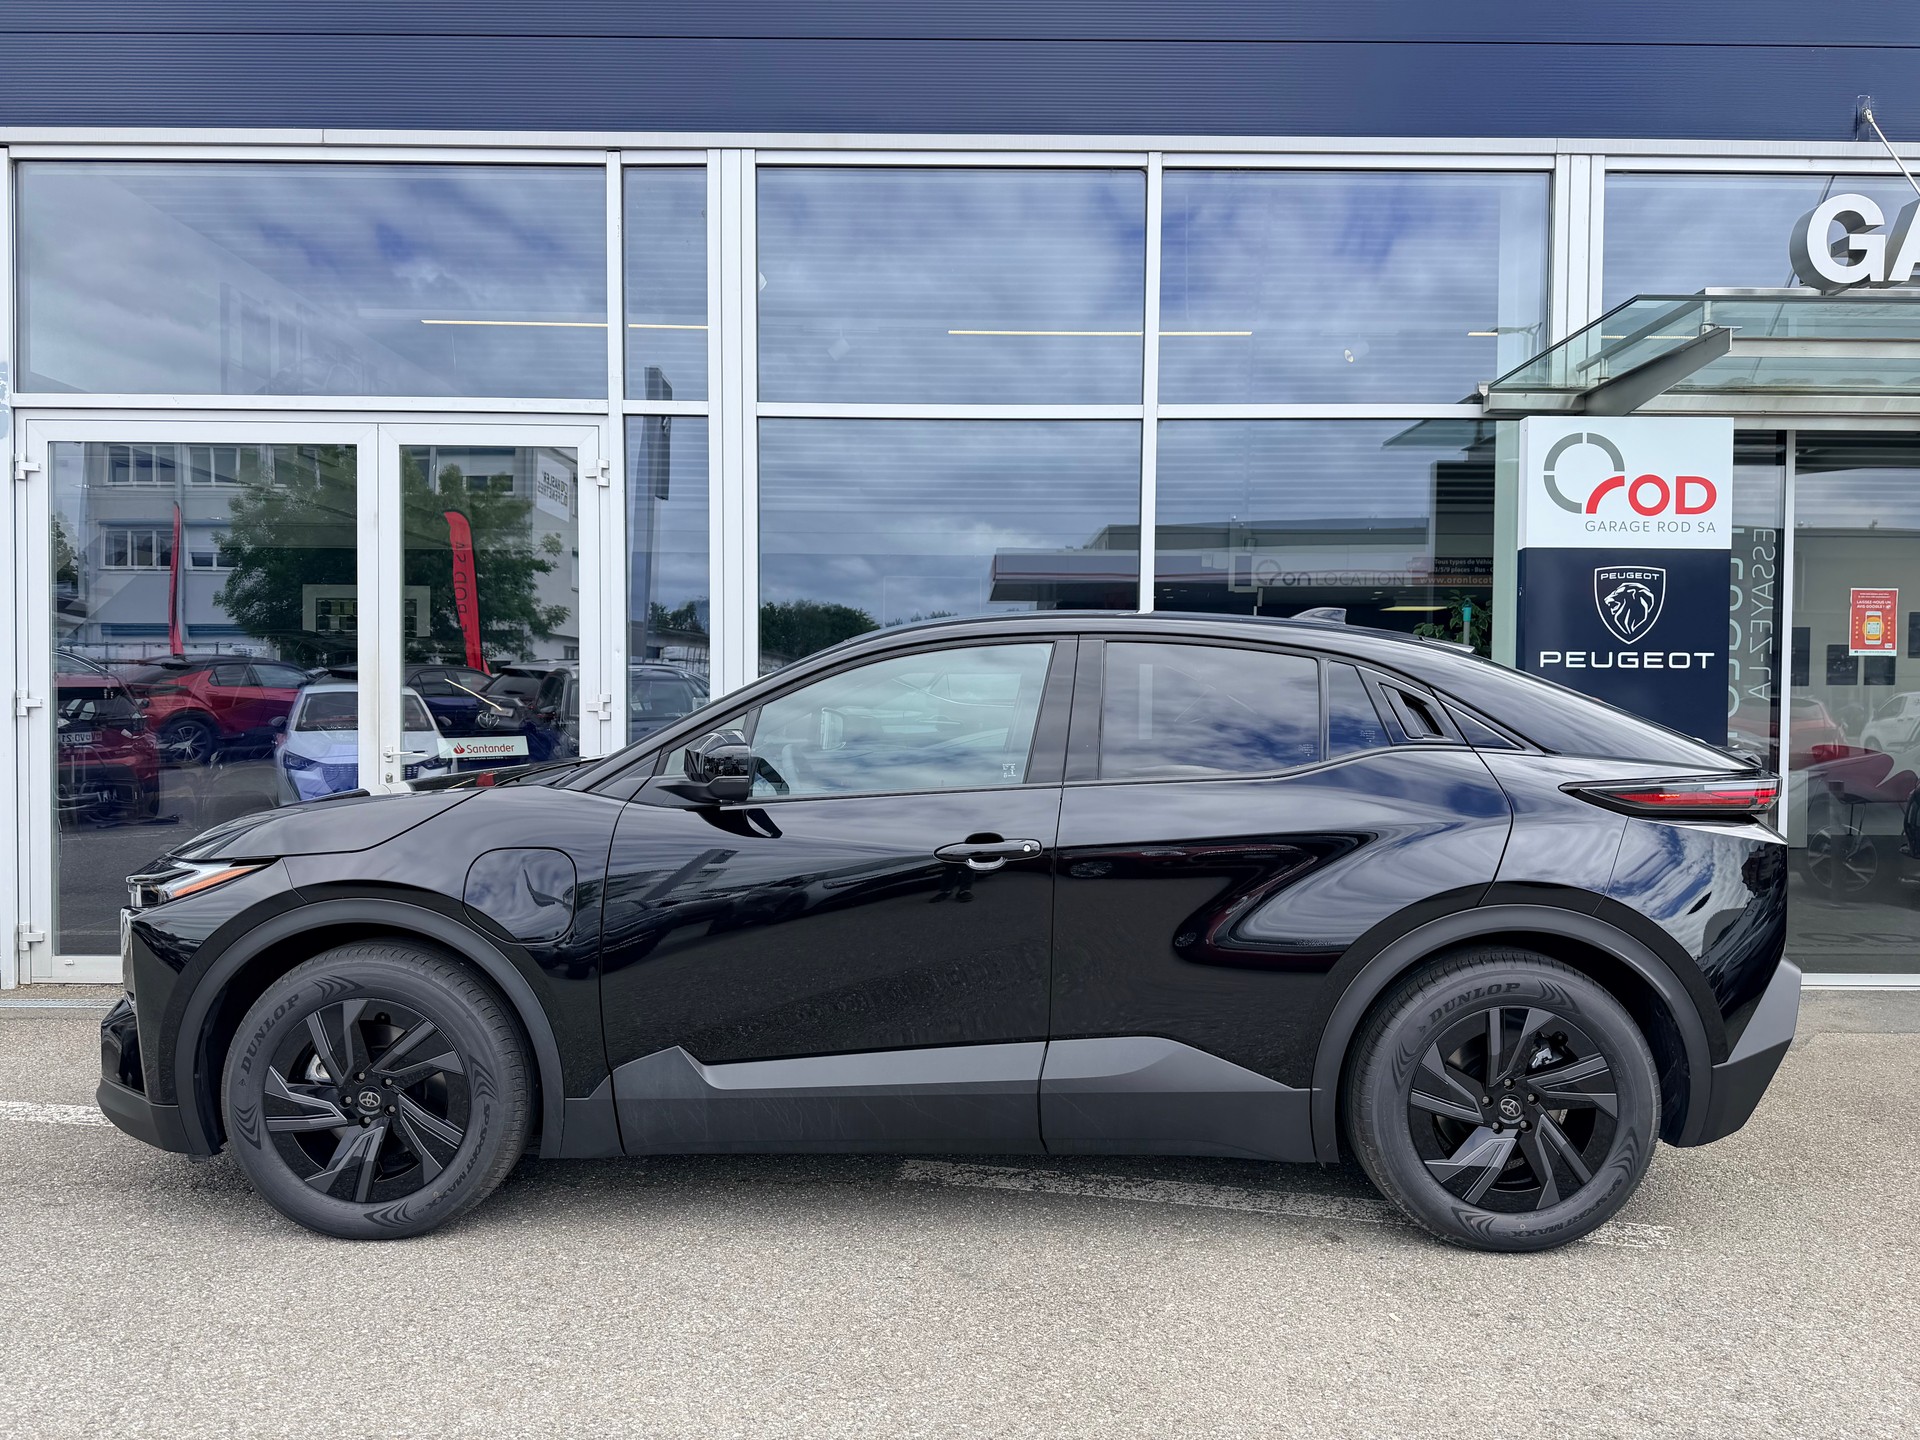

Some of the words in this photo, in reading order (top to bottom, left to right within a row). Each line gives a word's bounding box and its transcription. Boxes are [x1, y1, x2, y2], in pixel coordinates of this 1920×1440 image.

[1584, 520, 1650, 533] GARAGE
[1657, 520, 1691, 533] ROD
[1697, 521, 1716, 533] SA
[1315, 571, 1405, 586] LOCATION
[1421, 576, 1493, 584] www.oronlocat
[1600, 571, 1660, 581] PEUGEOT
[1539, 650, 1715, 669] PEUGEOT
[466, 743, 515, 754] Santander
[1428, 982, 1521, 1025] DUNLOP
[240, 993, 299, 1075] DUNLOP
